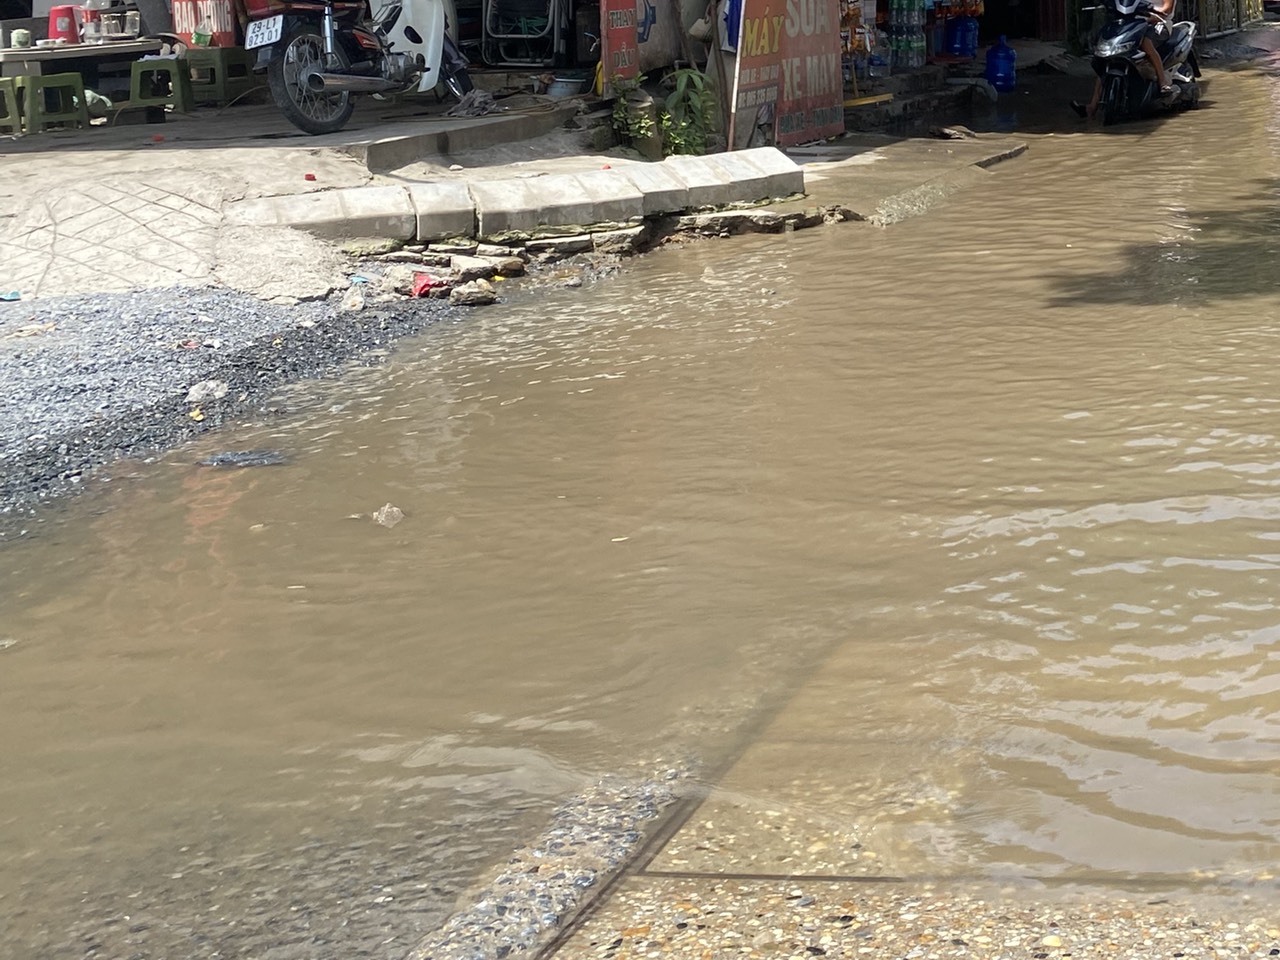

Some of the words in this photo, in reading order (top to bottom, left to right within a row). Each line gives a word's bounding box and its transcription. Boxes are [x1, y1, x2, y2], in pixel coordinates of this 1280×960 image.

[609, 9, 636, 29] THAY
[742, 6, 785, 58] MÁY
[782, 58, 802, 101] XE
